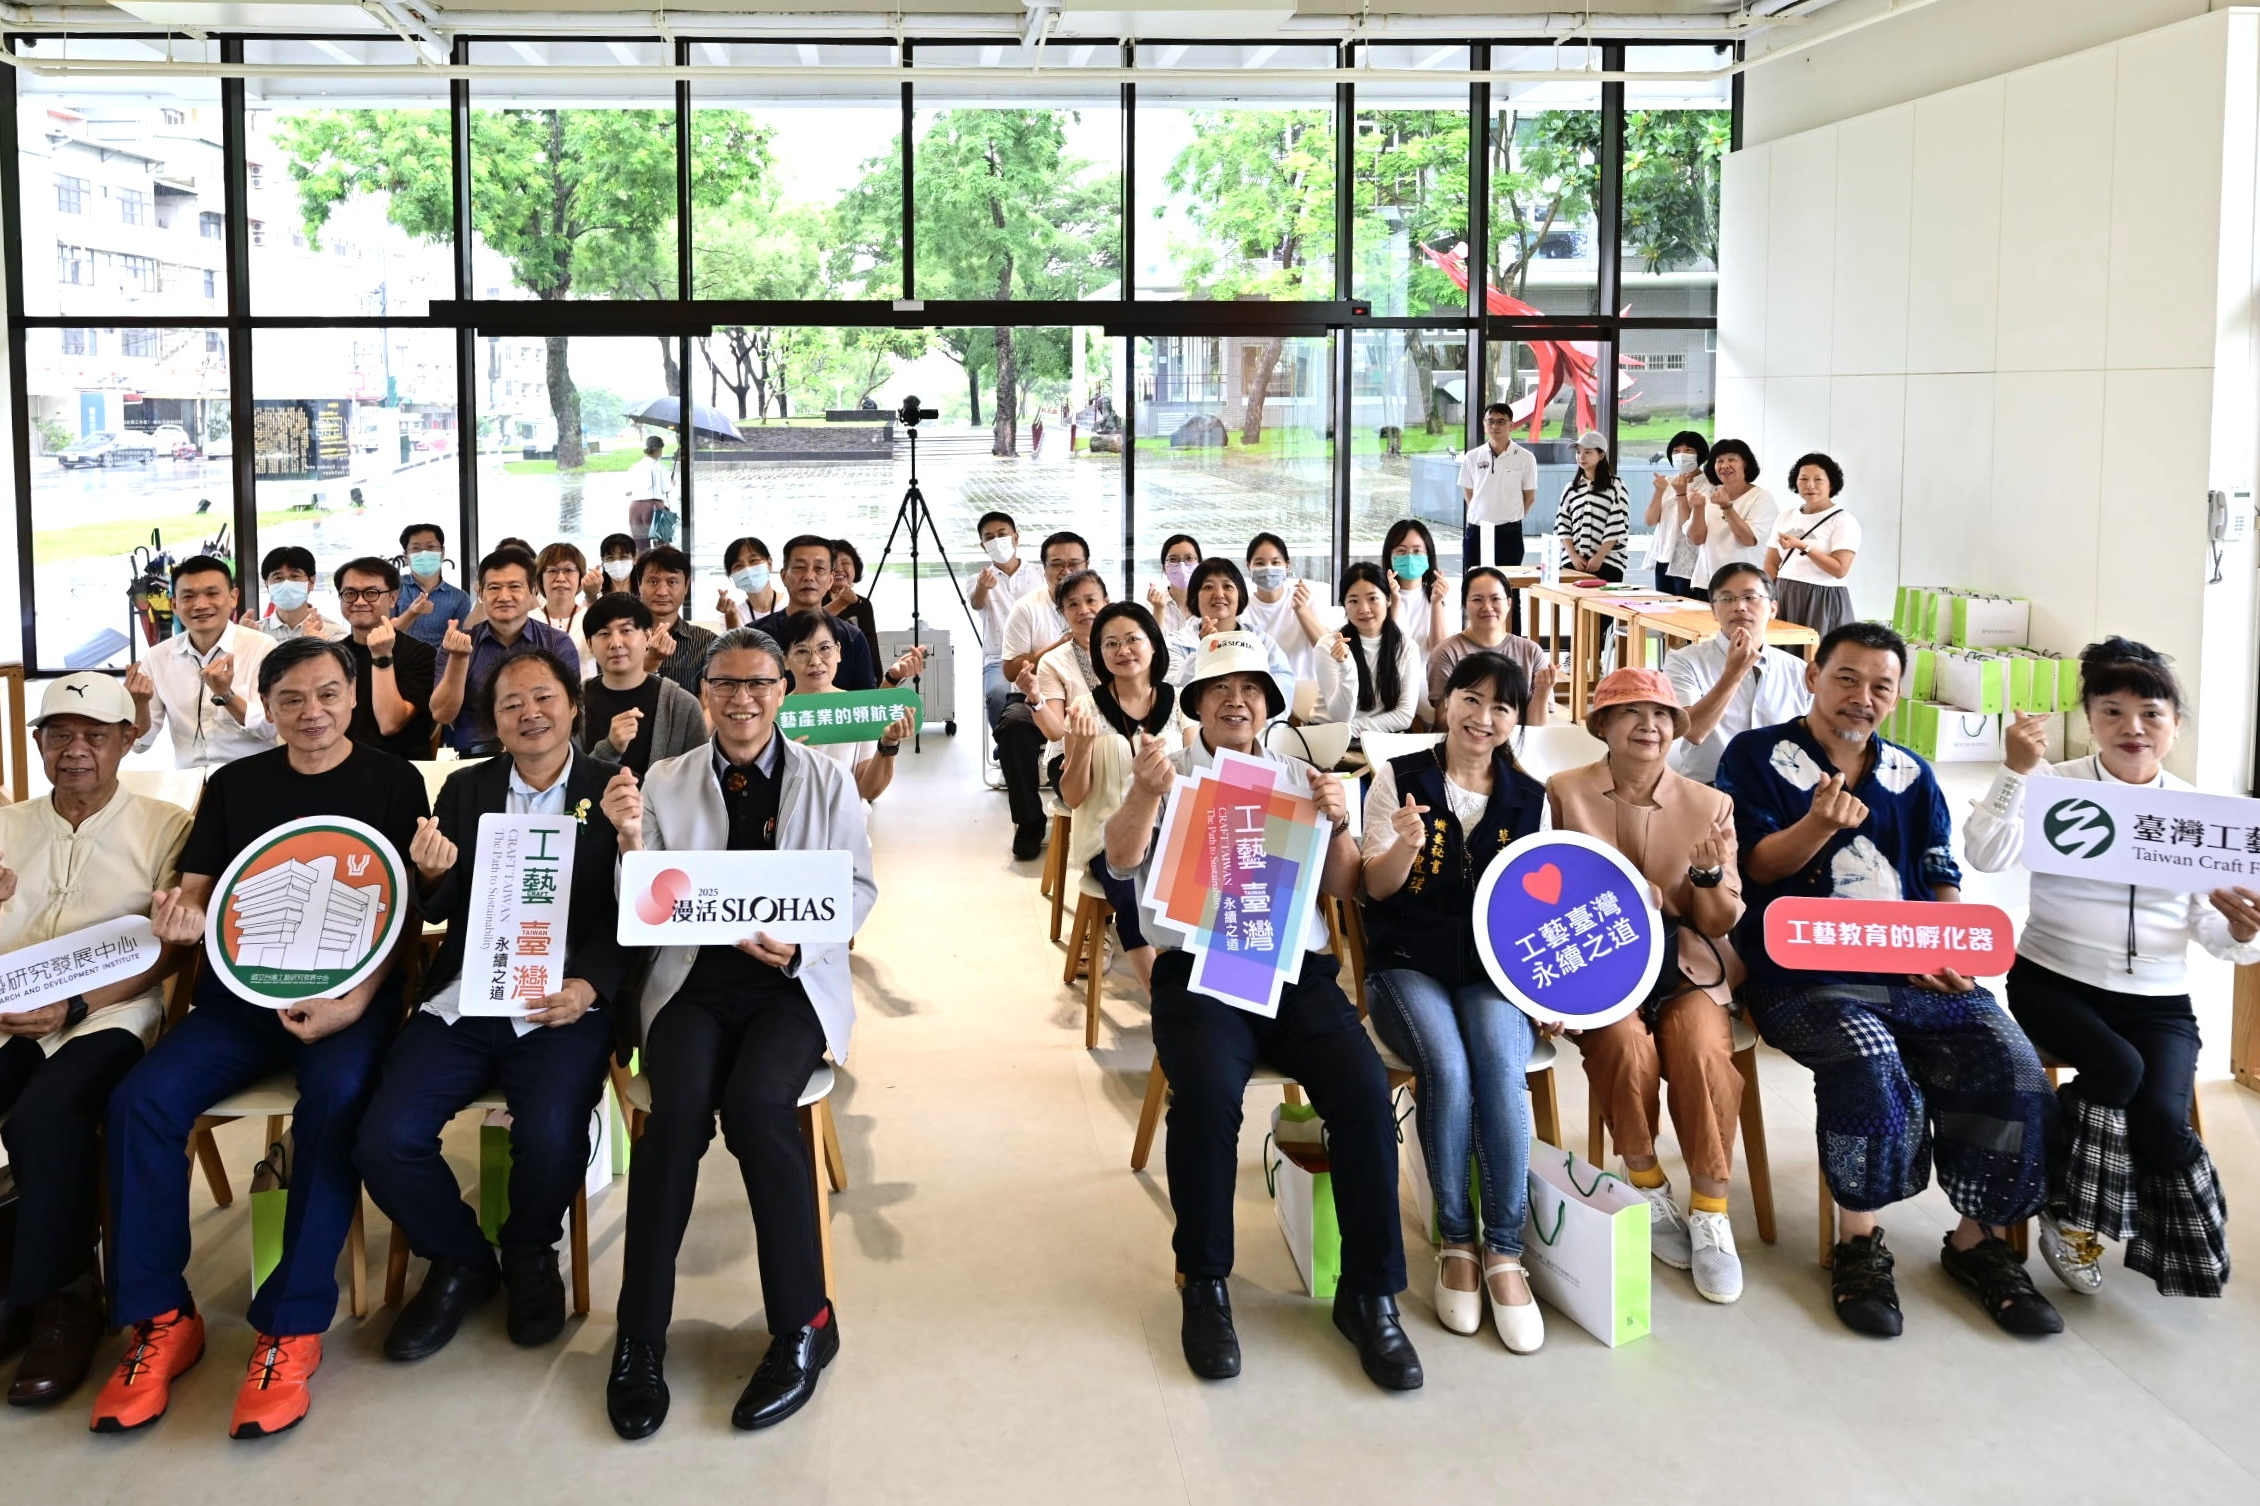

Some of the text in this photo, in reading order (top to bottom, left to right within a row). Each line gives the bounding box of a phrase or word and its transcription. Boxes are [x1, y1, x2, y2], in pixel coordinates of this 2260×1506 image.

[500, 828, 519, 923] CRAFT TAIWAN
[1206, 807, 1222, 910] The Path to Sustainability
[1218, 807, 1233, 886] CRAFT TAIWAN
[1234, 805, 1274, 951] 工藝臺灣
[2132, 846, 2193, 867] Taiwan
[2198, 855, 2243, 873] Craft
[480, 828, 505, 950] The Path to Sustainability
[672, 899, 717, 923] 漫活
[697, 888, 719, 897] 2025
[721, 896, 836, 923] SLOHAS
[1223, 897, 1239, 951] 永續之道
[1514, 890, 1622, 963] 工藝臺灣
[1531, 917, 1640, 989] 永續之道
[1787, 920, 1994, 952] 工藝教育的孵化器
[24, 985, 41, 996] AND
[44, 966, 99, 990] DEVELOPMENT
[102, 952, 140, 969] INSTITUTE
[489, 936, 510, 1001] 永續之道
